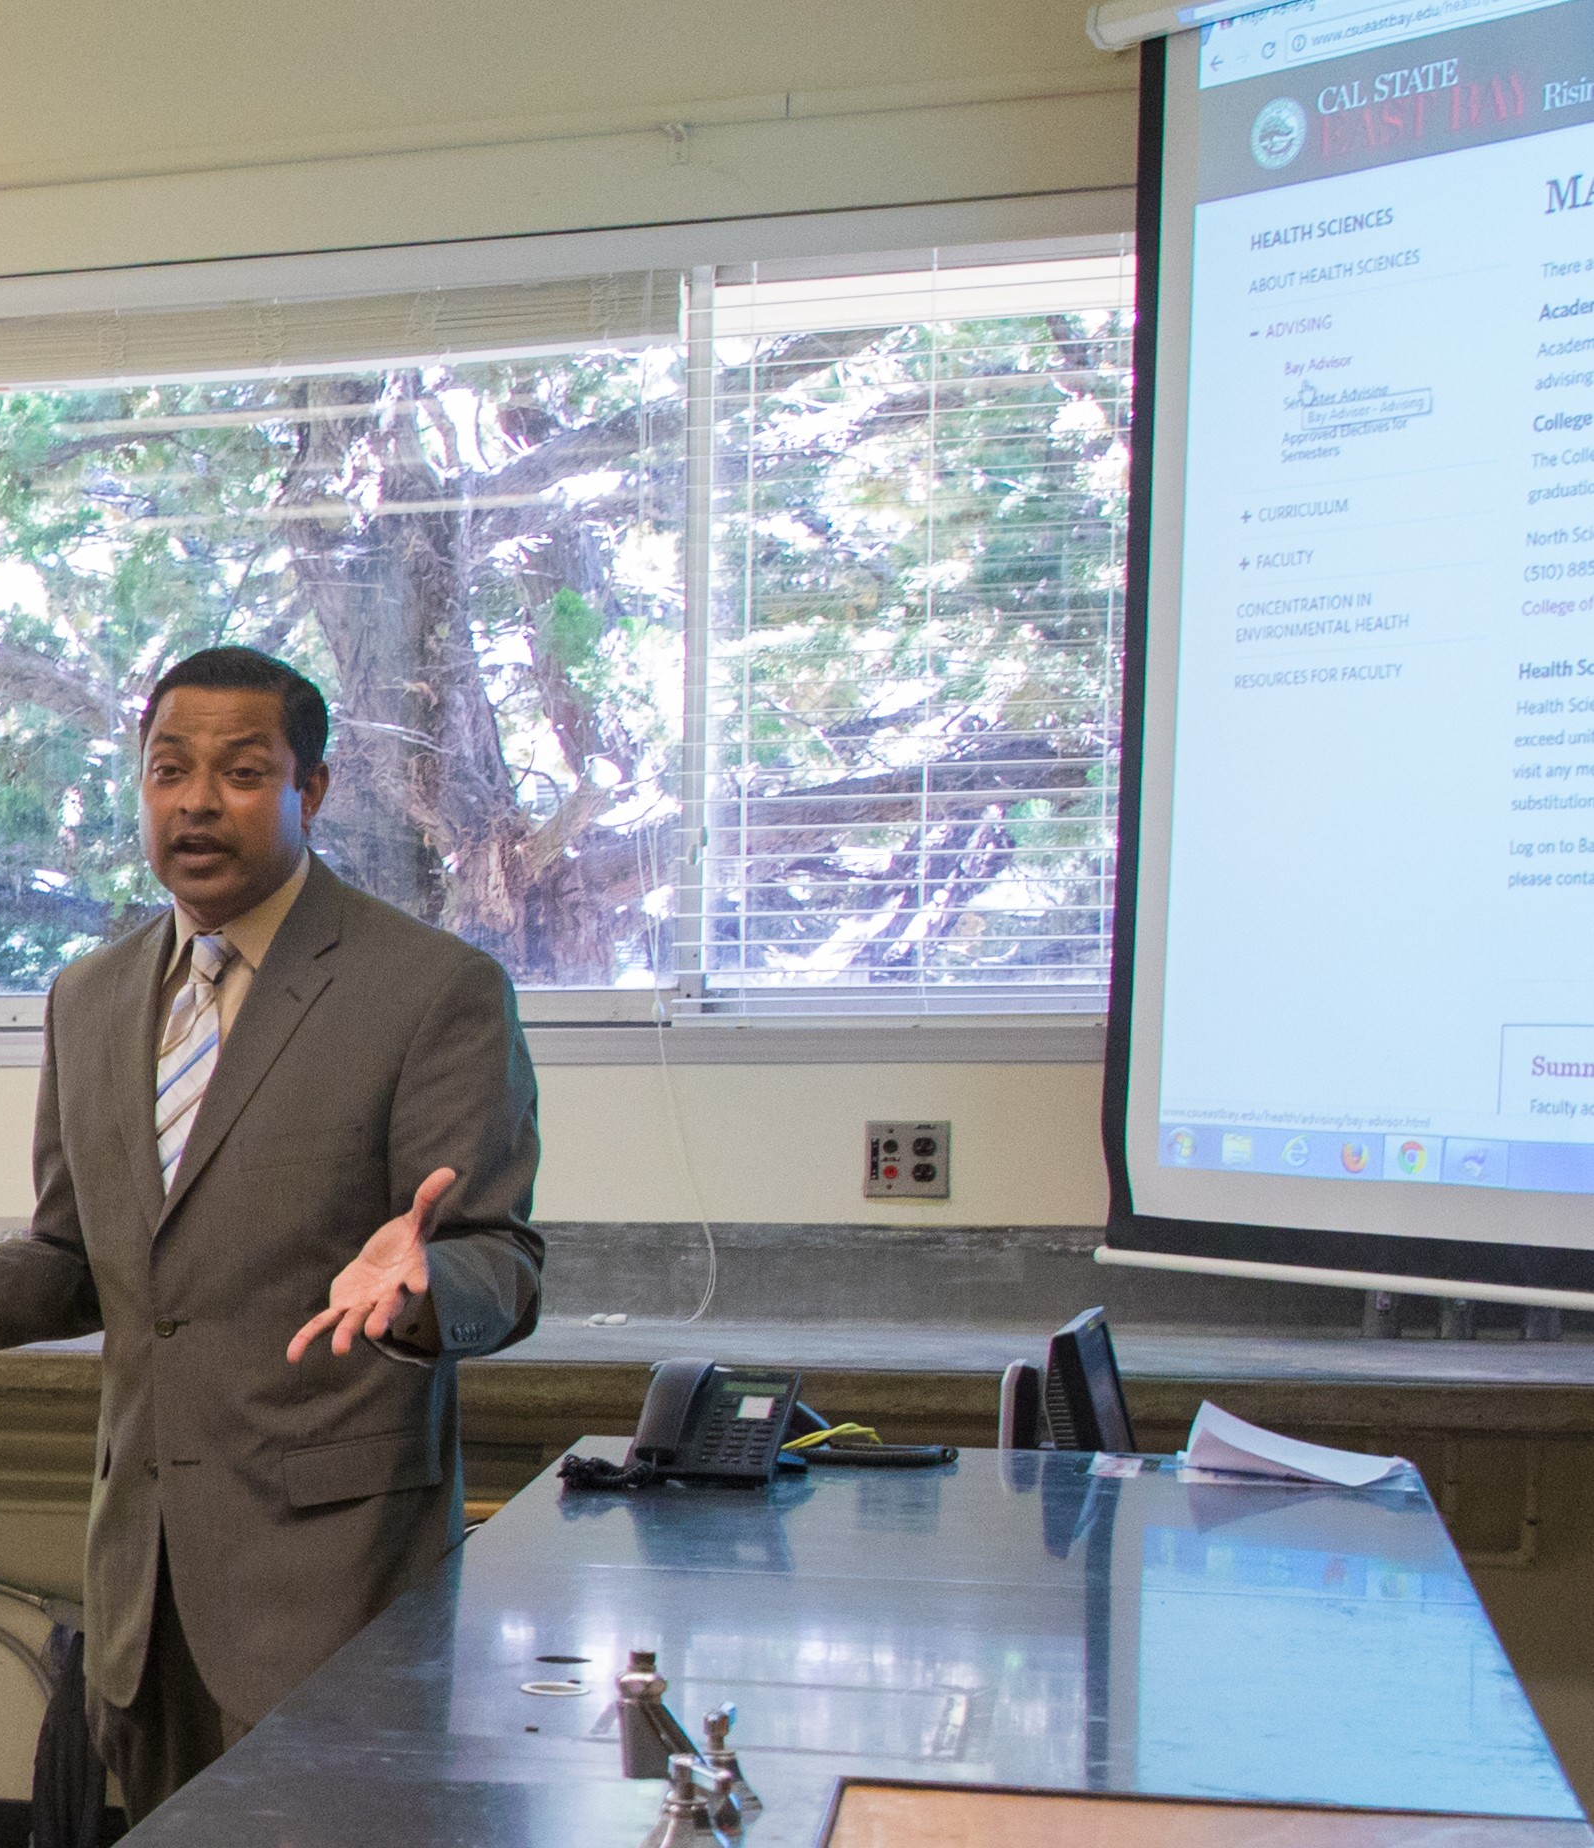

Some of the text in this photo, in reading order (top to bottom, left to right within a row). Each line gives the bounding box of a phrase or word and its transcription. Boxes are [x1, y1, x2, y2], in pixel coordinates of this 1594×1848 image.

[1318, 58, 1460, 115] CAL STATE
[1451, 72, 1527, 132] BAY
[1250, 208, 1394, 251] HEALTH SCIENCES
[1248, 249, 1420, 295] ABOUT HEALTH SCIENCES
[1541, 260, 1582, 279] There
[1265, 315, 1333, 339] ADVISING
[1283, 356, 1353, 376] Bay Advisor
[1532, 411, 1593, 433] College
[1280, 445, 1341, 465] Semesters
[1531, 452, 1558, 469] The
[1258, 498, 1349, 523] CURRICULUM
[1526, 528, 1568, 547] North
[1255, 550, 1314, 570] FACULTY
[1523, 563, 1564, 583] (510)
[1235, 593, 1372, 619] CONCENTRATION IN
[1521, 600, 1575, 618] College
[1235, 614, 1410, 643] ENVIRONMENTAL HEALTH
[1233, 664, 1403, 690] RESOURCES FOR FACULTY
[1519, 660, 1573, 680] Health
[1516, 699, 1564, 716] Health
[1513, 729, 1565, 747] exceed
[1513, 763, 1571, 781] visit any
[1509, 839, 1575, 858] Log on to
[1508, 871, 1552, 889] please
[1530, 1099, 1577, 1119] Faculty
